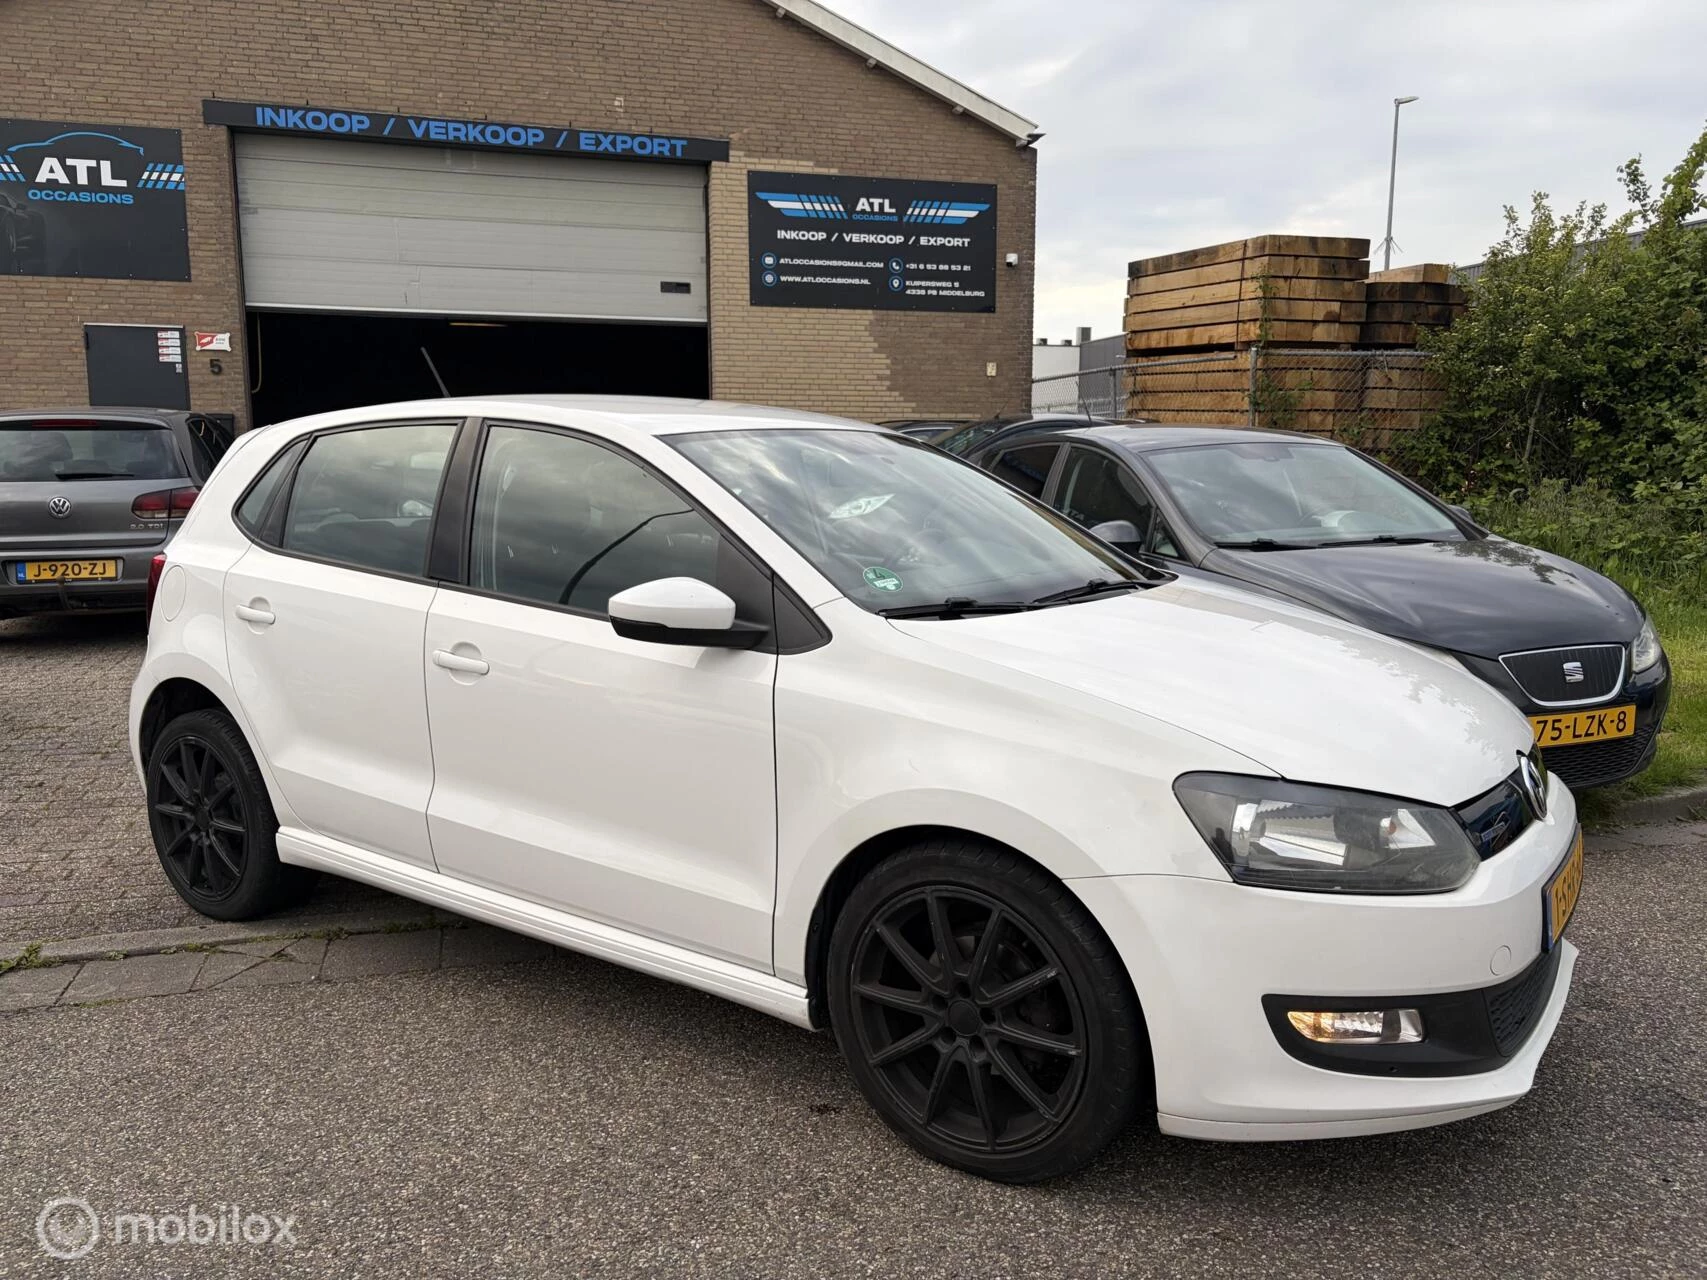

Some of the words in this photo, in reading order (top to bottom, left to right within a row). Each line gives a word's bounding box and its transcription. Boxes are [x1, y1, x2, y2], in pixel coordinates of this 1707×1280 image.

[255, 106, 370, 134] INKOOP
[382, 117, 396, 136] /
[408, 118, 545, 147] VERKOOP
[555, 130, 568, 149] /
[579, 131, 688, 157] EXPORT
[35, 157, 127, 187] ATL
[28, 189, 134, 205] OCCASIONS
[855, 197, 896, 213] ATL
[852, 213, 898, 222] OCCASIONS
[776, 229, 827, 241] INKOOP
[831, 232, 838, 242] /
[842, 233, 905, 245] VERKOOP
[908, 236, 916, 246] /
[919, 236, 971, 248] EXPORT
[779, 275, 871, 285] WWW.ATLOCCASIONS.NL
[939, 290, 986, 298] MIDDELBURG
[210, 359, 222, 375] 5
[33, 562, 107, 578] J-920-ZJ
[1535, 711, 1628, 743] 75-LZK-8
